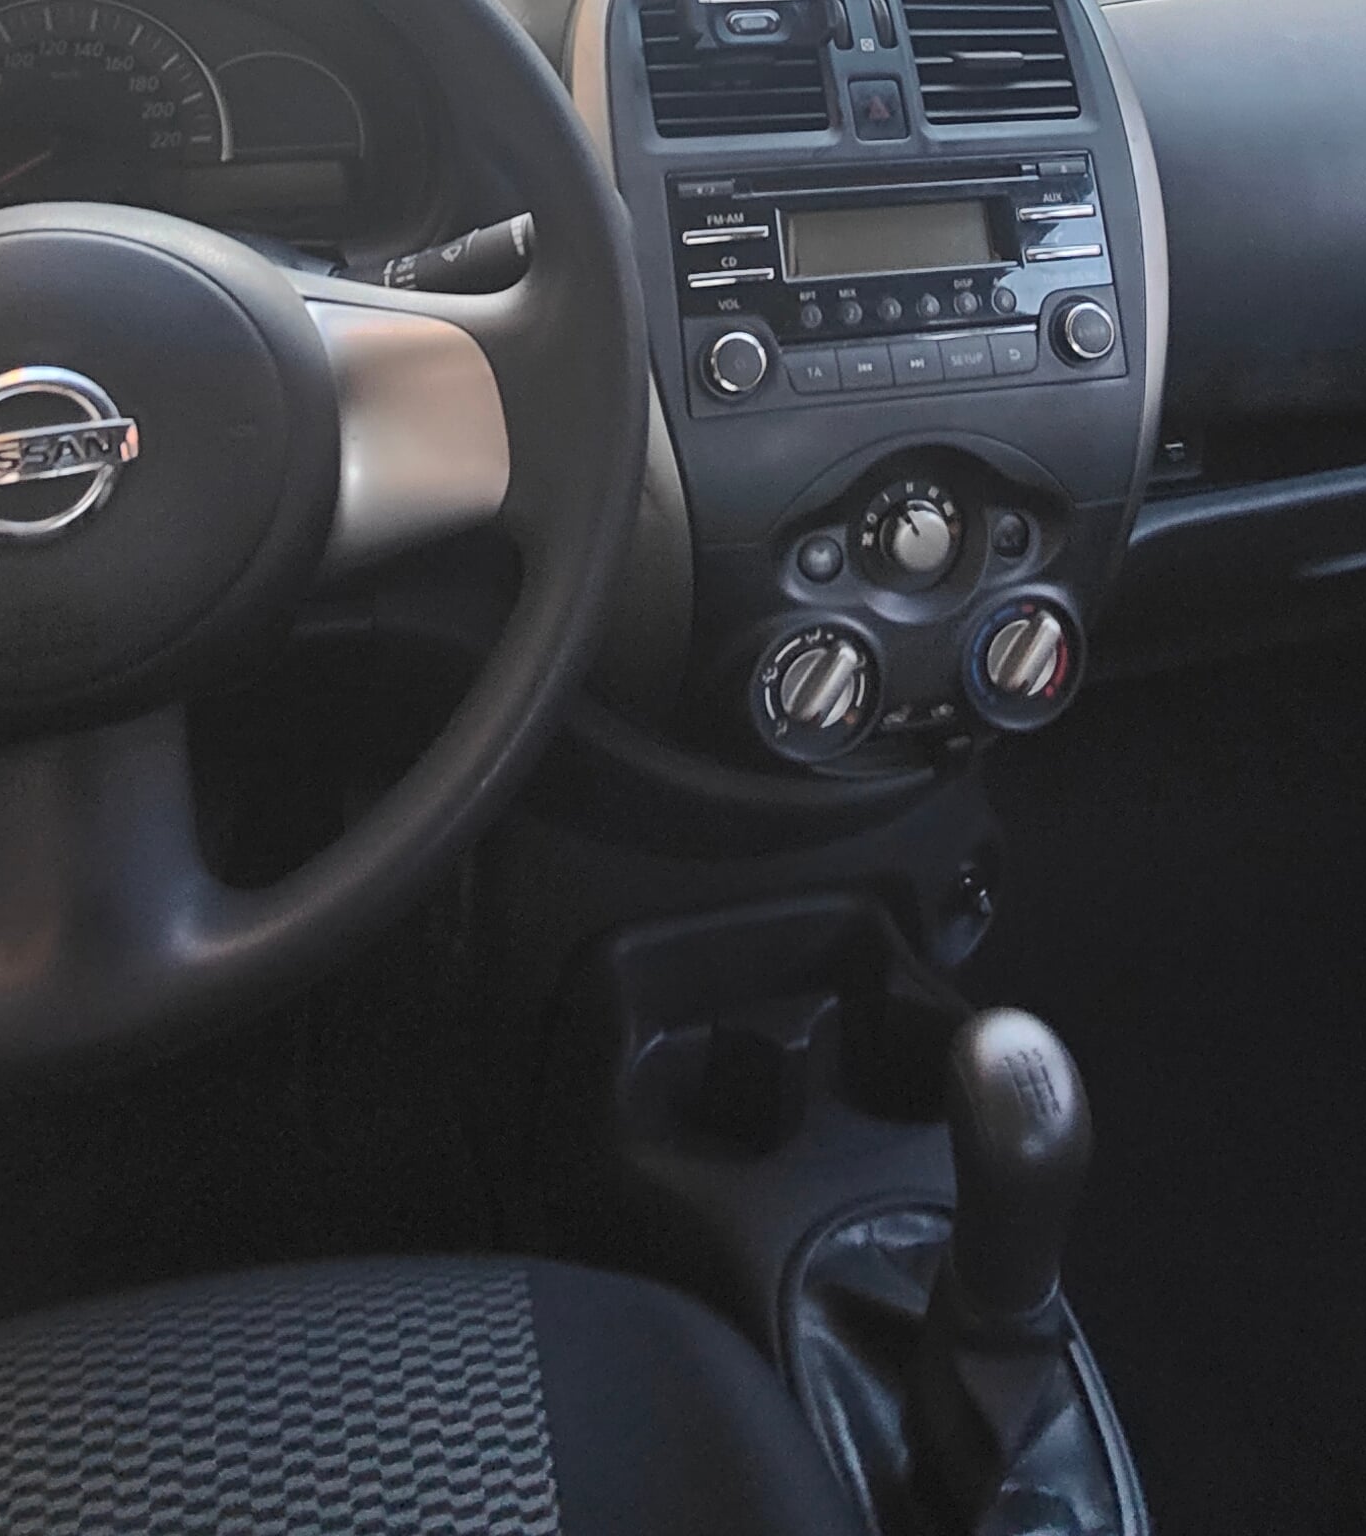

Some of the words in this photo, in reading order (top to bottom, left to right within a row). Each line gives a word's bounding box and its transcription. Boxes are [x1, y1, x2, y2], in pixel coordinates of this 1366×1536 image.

[1042, 192, 1063, 203] AUX
[720, 256, 738, 268] CD
[717, 297, 740, 311] VOL
[806, 365, 823, 379] TA
